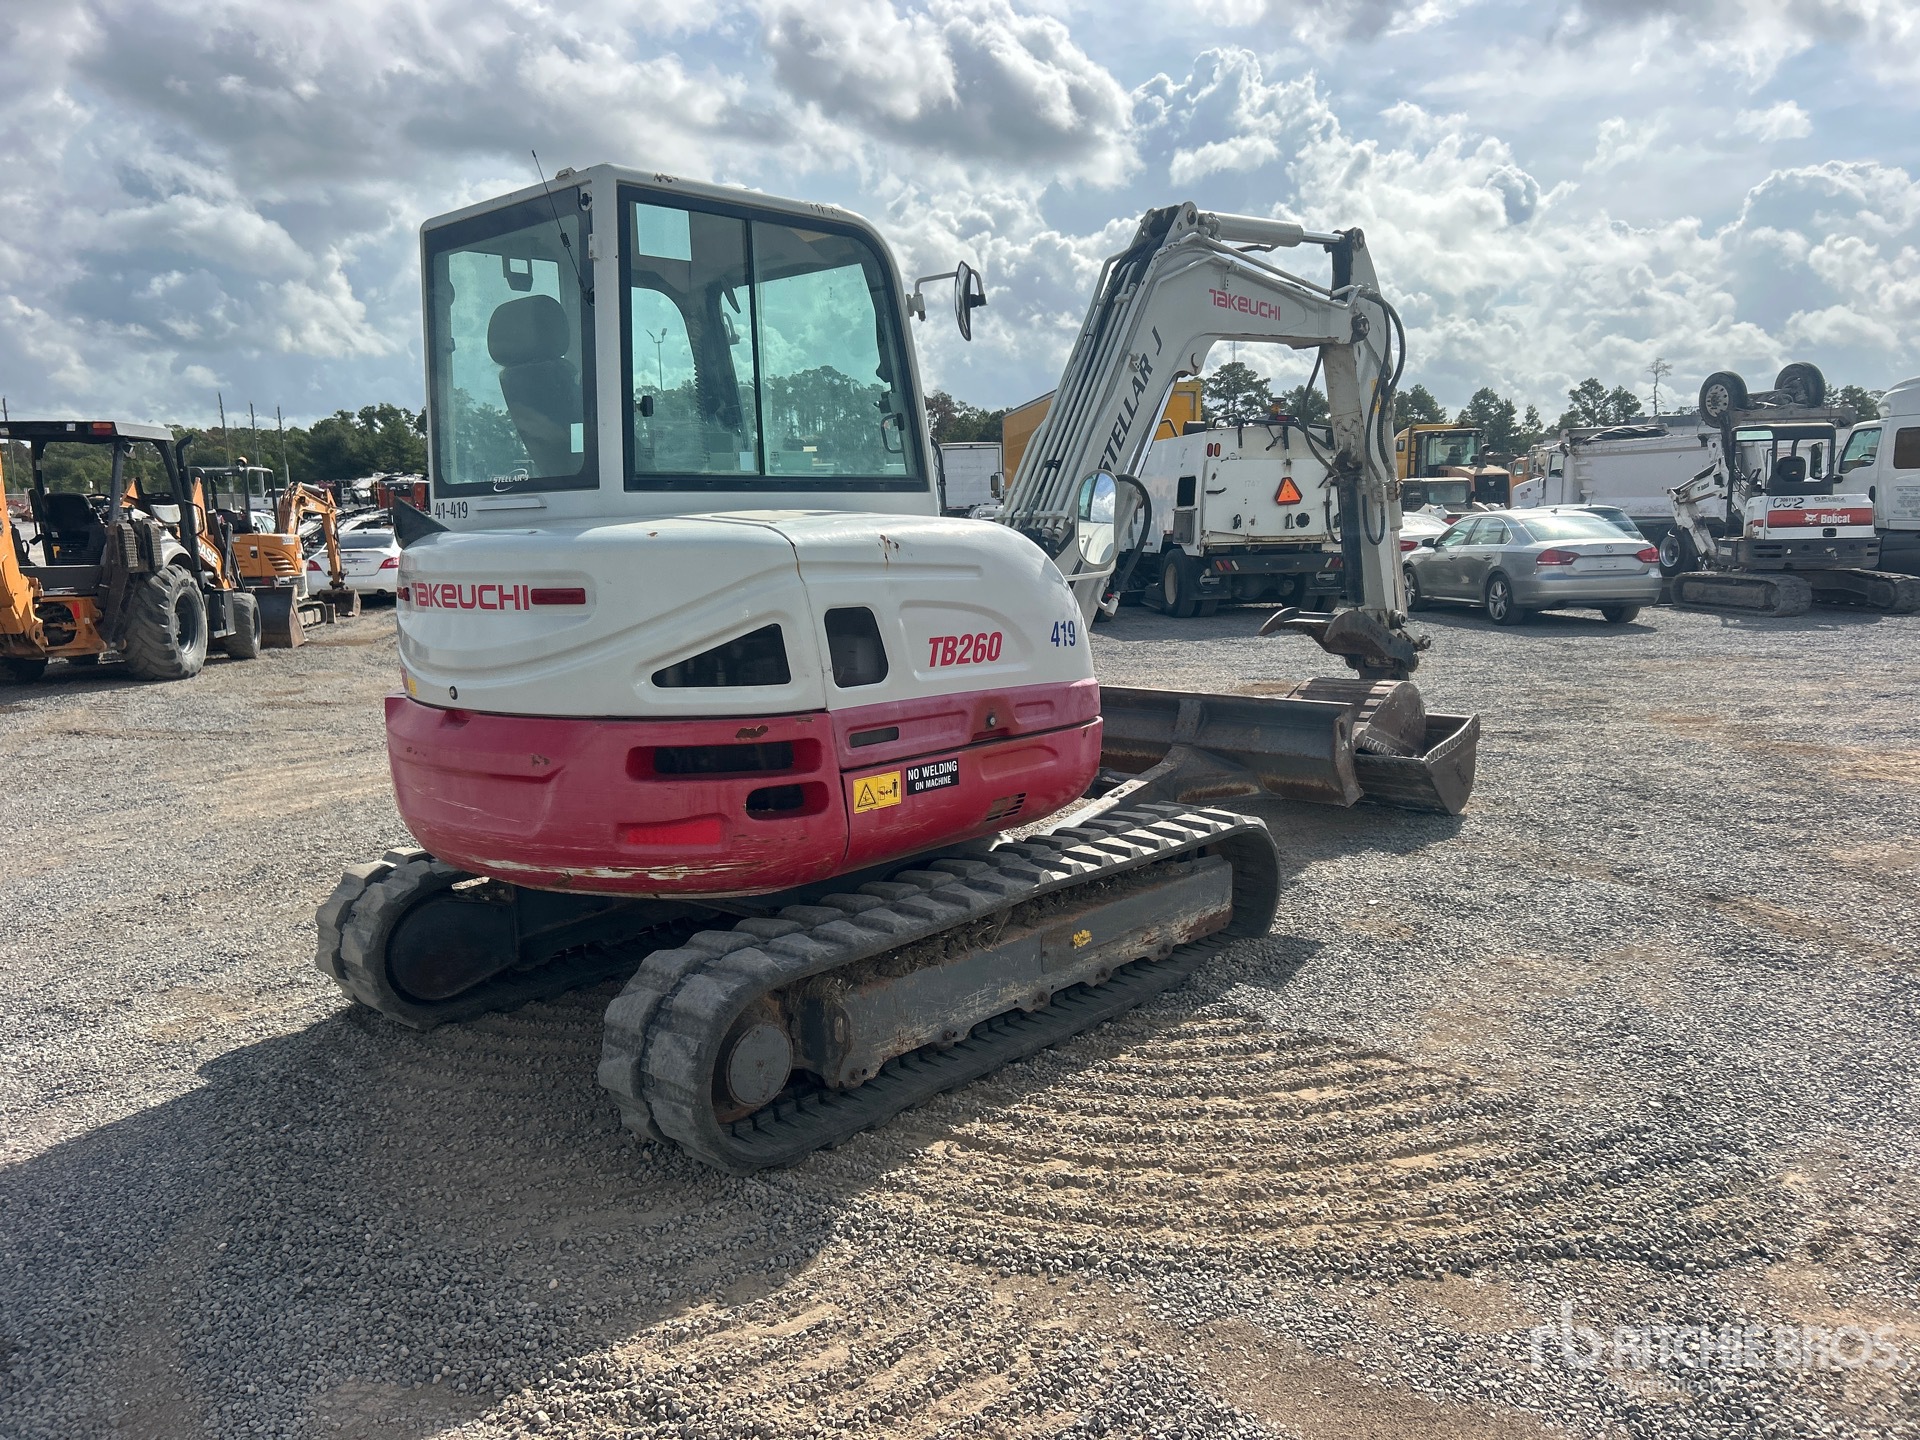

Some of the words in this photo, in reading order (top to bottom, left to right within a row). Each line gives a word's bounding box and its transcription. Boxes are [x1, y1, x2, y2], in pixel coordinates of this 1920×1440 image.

[434, 501, 468, 519] 41-419
[1820, 514, 1850, 524] Bobcat
[197, 543, 219, 567] ASE
[1050, 620, 1076, 647] 419
[928, 632, 1003, 667] TB260
[908, 768, 920, 781] NO
[921, 760, 958, 777] WELDING
[915, 781, 924, 791] ON
[925, 775, 952, 788] MACHINE
